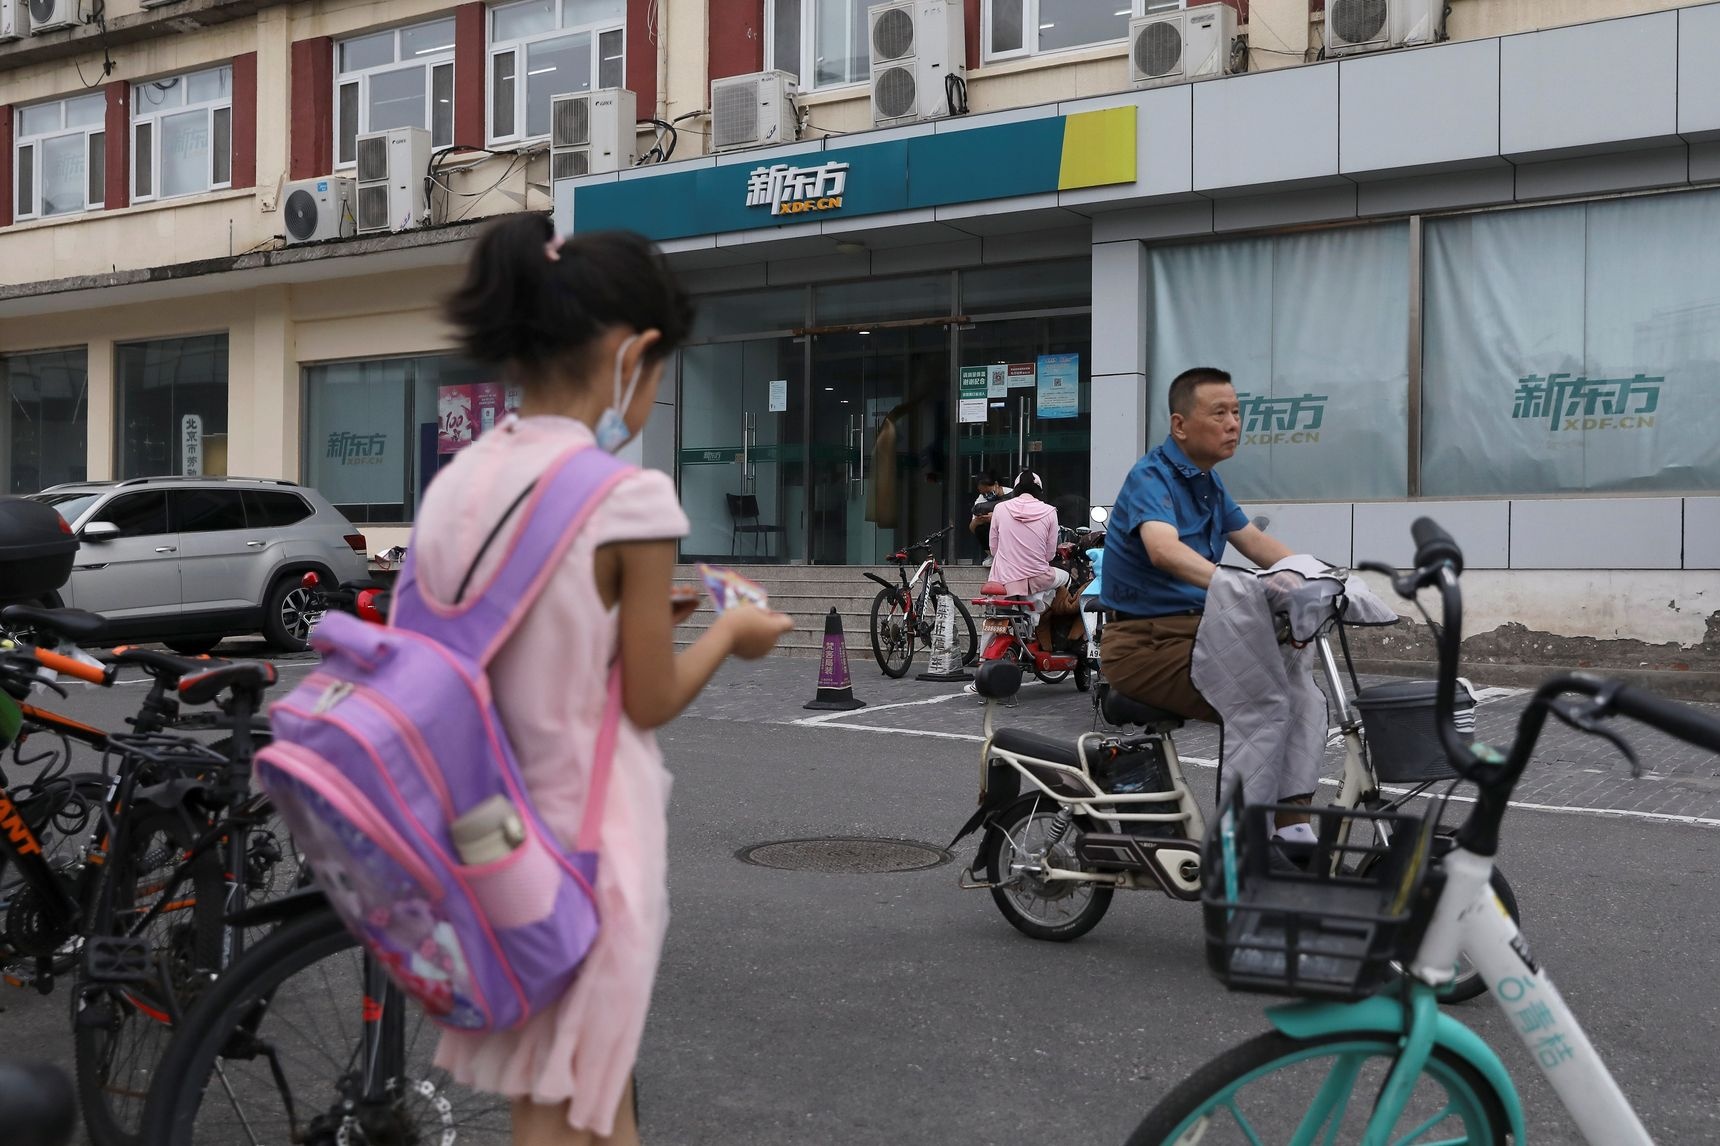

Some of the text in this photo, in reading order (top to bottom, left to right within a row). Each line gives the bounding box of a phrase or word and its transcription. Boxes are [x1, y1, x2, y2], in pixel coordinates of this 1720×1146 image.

[746, 161, 850, 215] 新东方
[780, 197, 843, 215] XDF.CN
[1512, 373, 1665, 431] 新东方
[1562, 416, 1656, 431] XDF.CN
[326, 431, 387, 465] 新东方
[1244, 431, 1320, 446] XDF.CN
[1089, 649, 1101, 658] A9
[1515, 1000, 1574, 1068] 青桔
